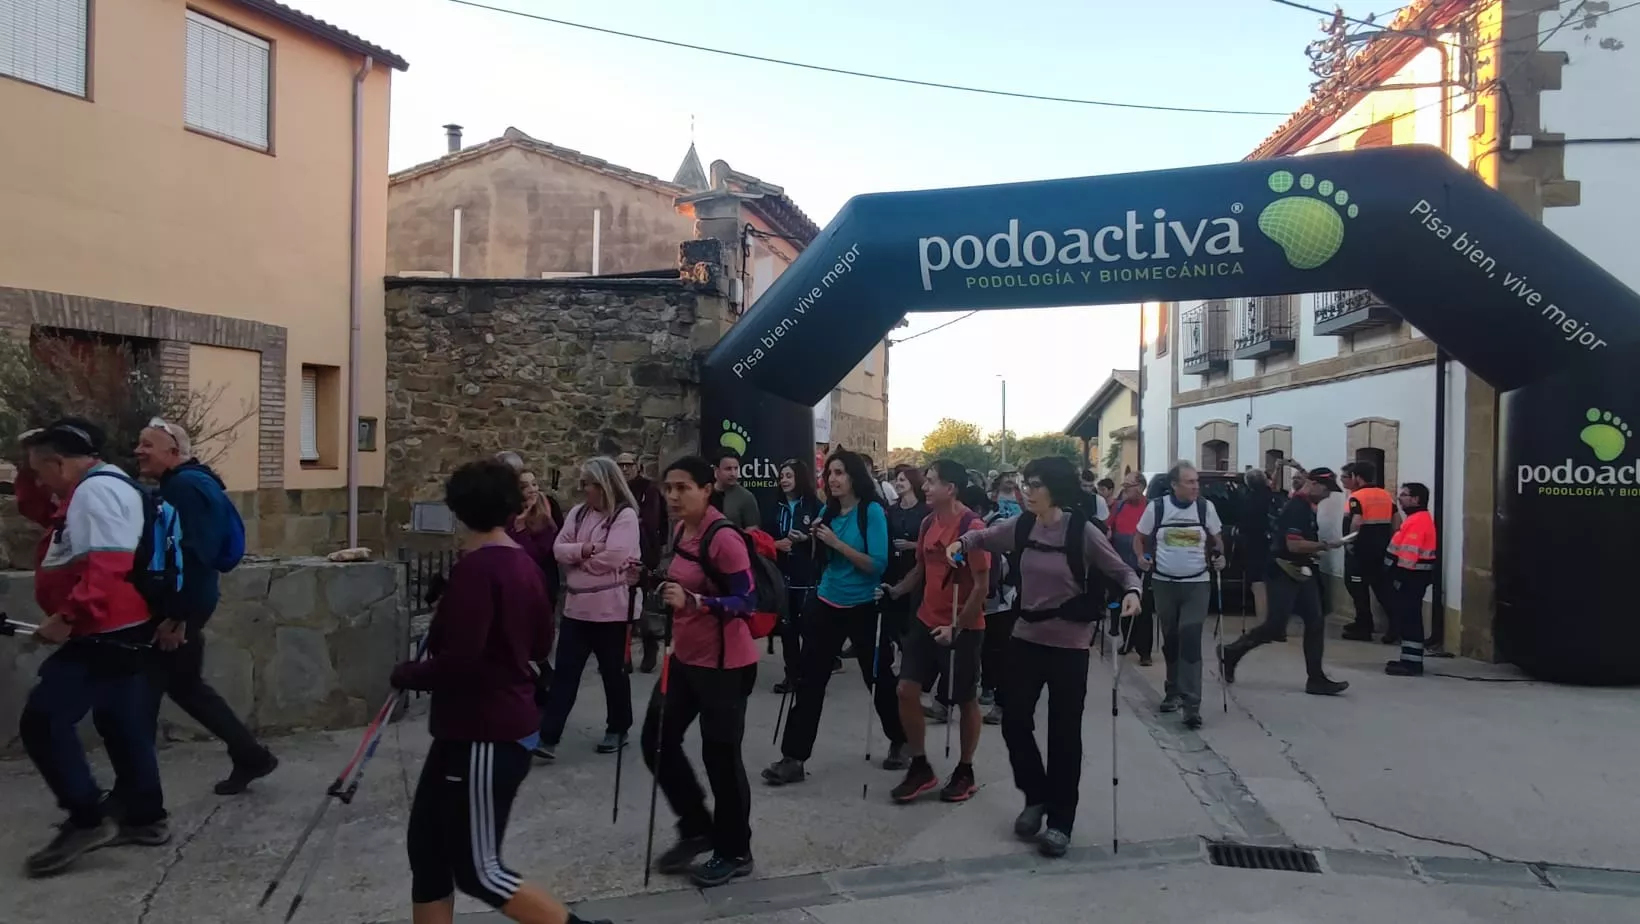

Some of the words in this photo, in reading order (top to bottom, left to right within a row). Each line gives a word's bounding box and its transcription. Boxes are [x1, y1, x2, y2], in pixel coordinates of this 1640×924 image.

[966, 268, 1075, 289] PODOLOGÍA
[1081, 271, 1091, 284] Y
[1100, 261, 1244, 283] BIOMECÁNICA
[1409, 199, 1452, 240] Pisa
[1452, 231, 1496, 279] bien,
[1503, 272, 1542, 306] vive
[1542, 303, 1607, 351] mejor
[732, 348, 765, 379] Pisa
[760, 317, 798, 349] bien,
[794, 286, 823, 314] vive
[821, 243, 861, 288] mejor
[738, 458, 780, 479] ctiv
[1538, 486, 1604, 496] PODOLOGÍA
[1609, 488, 1616, 496] Y
[1620, 488, 1640, 497] BIO
